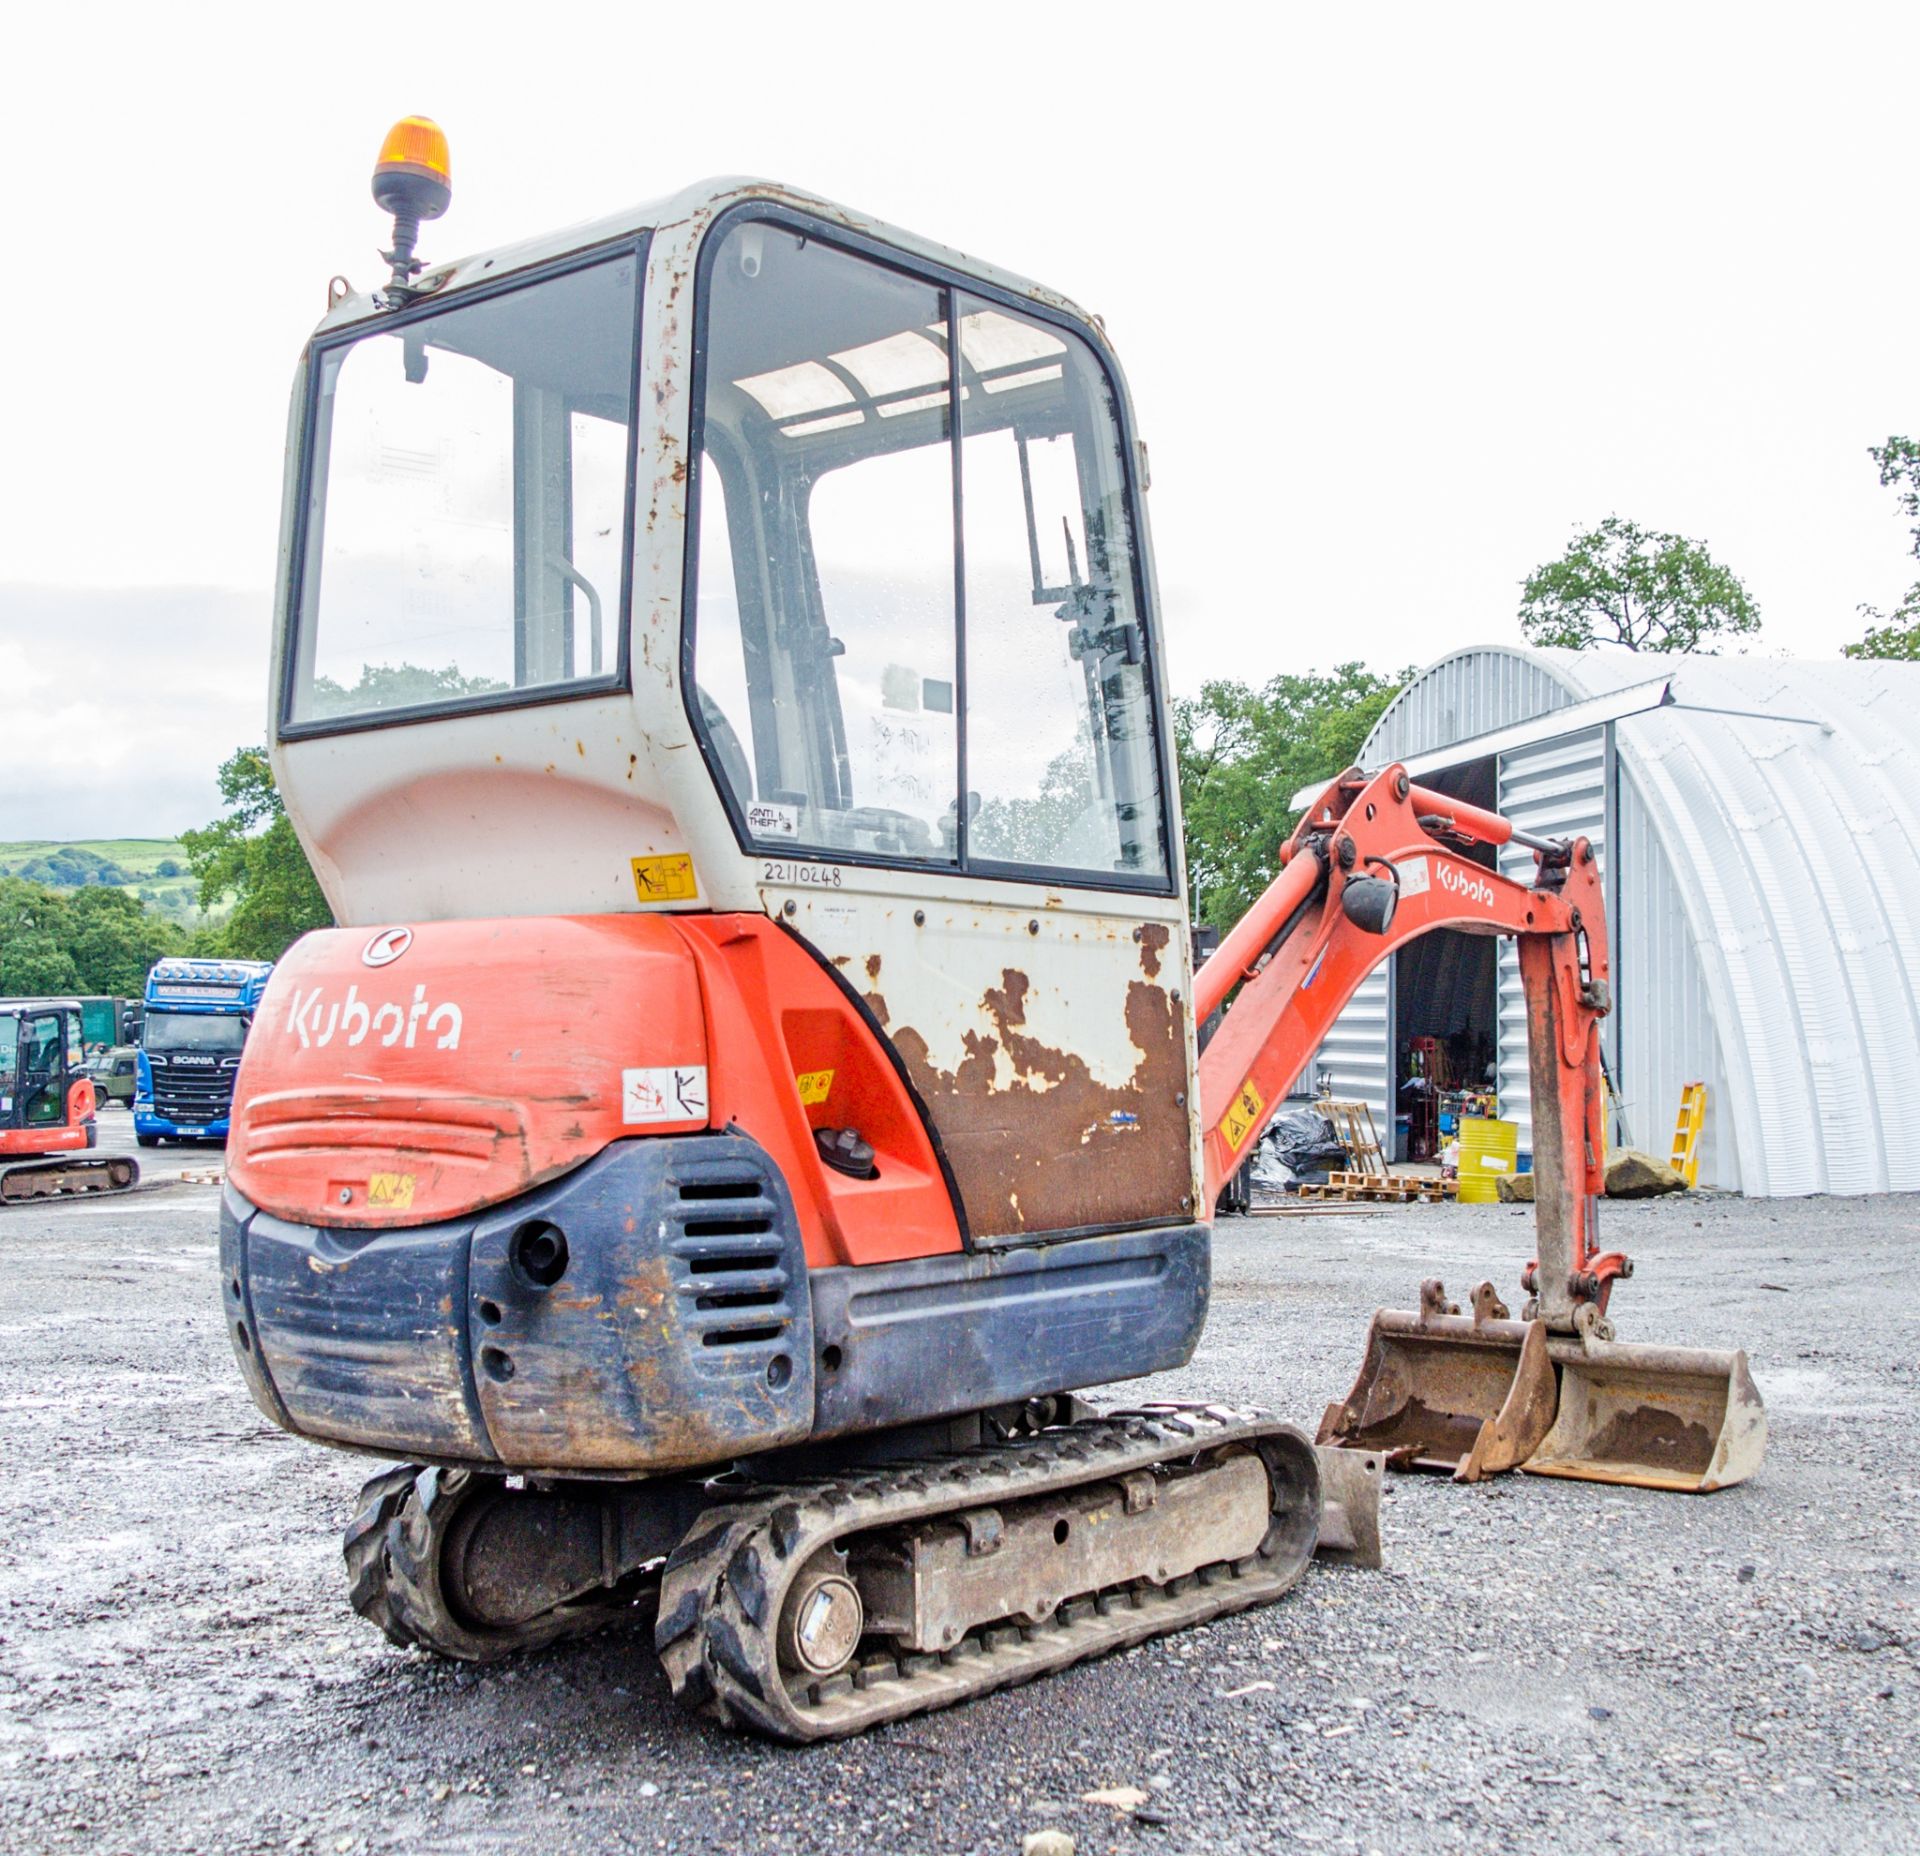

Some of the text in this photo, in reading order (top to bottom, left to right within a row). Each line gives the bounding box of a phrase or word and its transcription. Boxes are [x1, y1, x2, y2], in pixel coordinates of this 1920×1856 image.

[749, 807, 774, 818] ANTI
[749, 816, 778, 828] THEFT
[1436, 861, 1494, 906] Kubota
[287, 984, 463, 1050] Kubota
[172, 1055, 216, 1066] SCANIA
